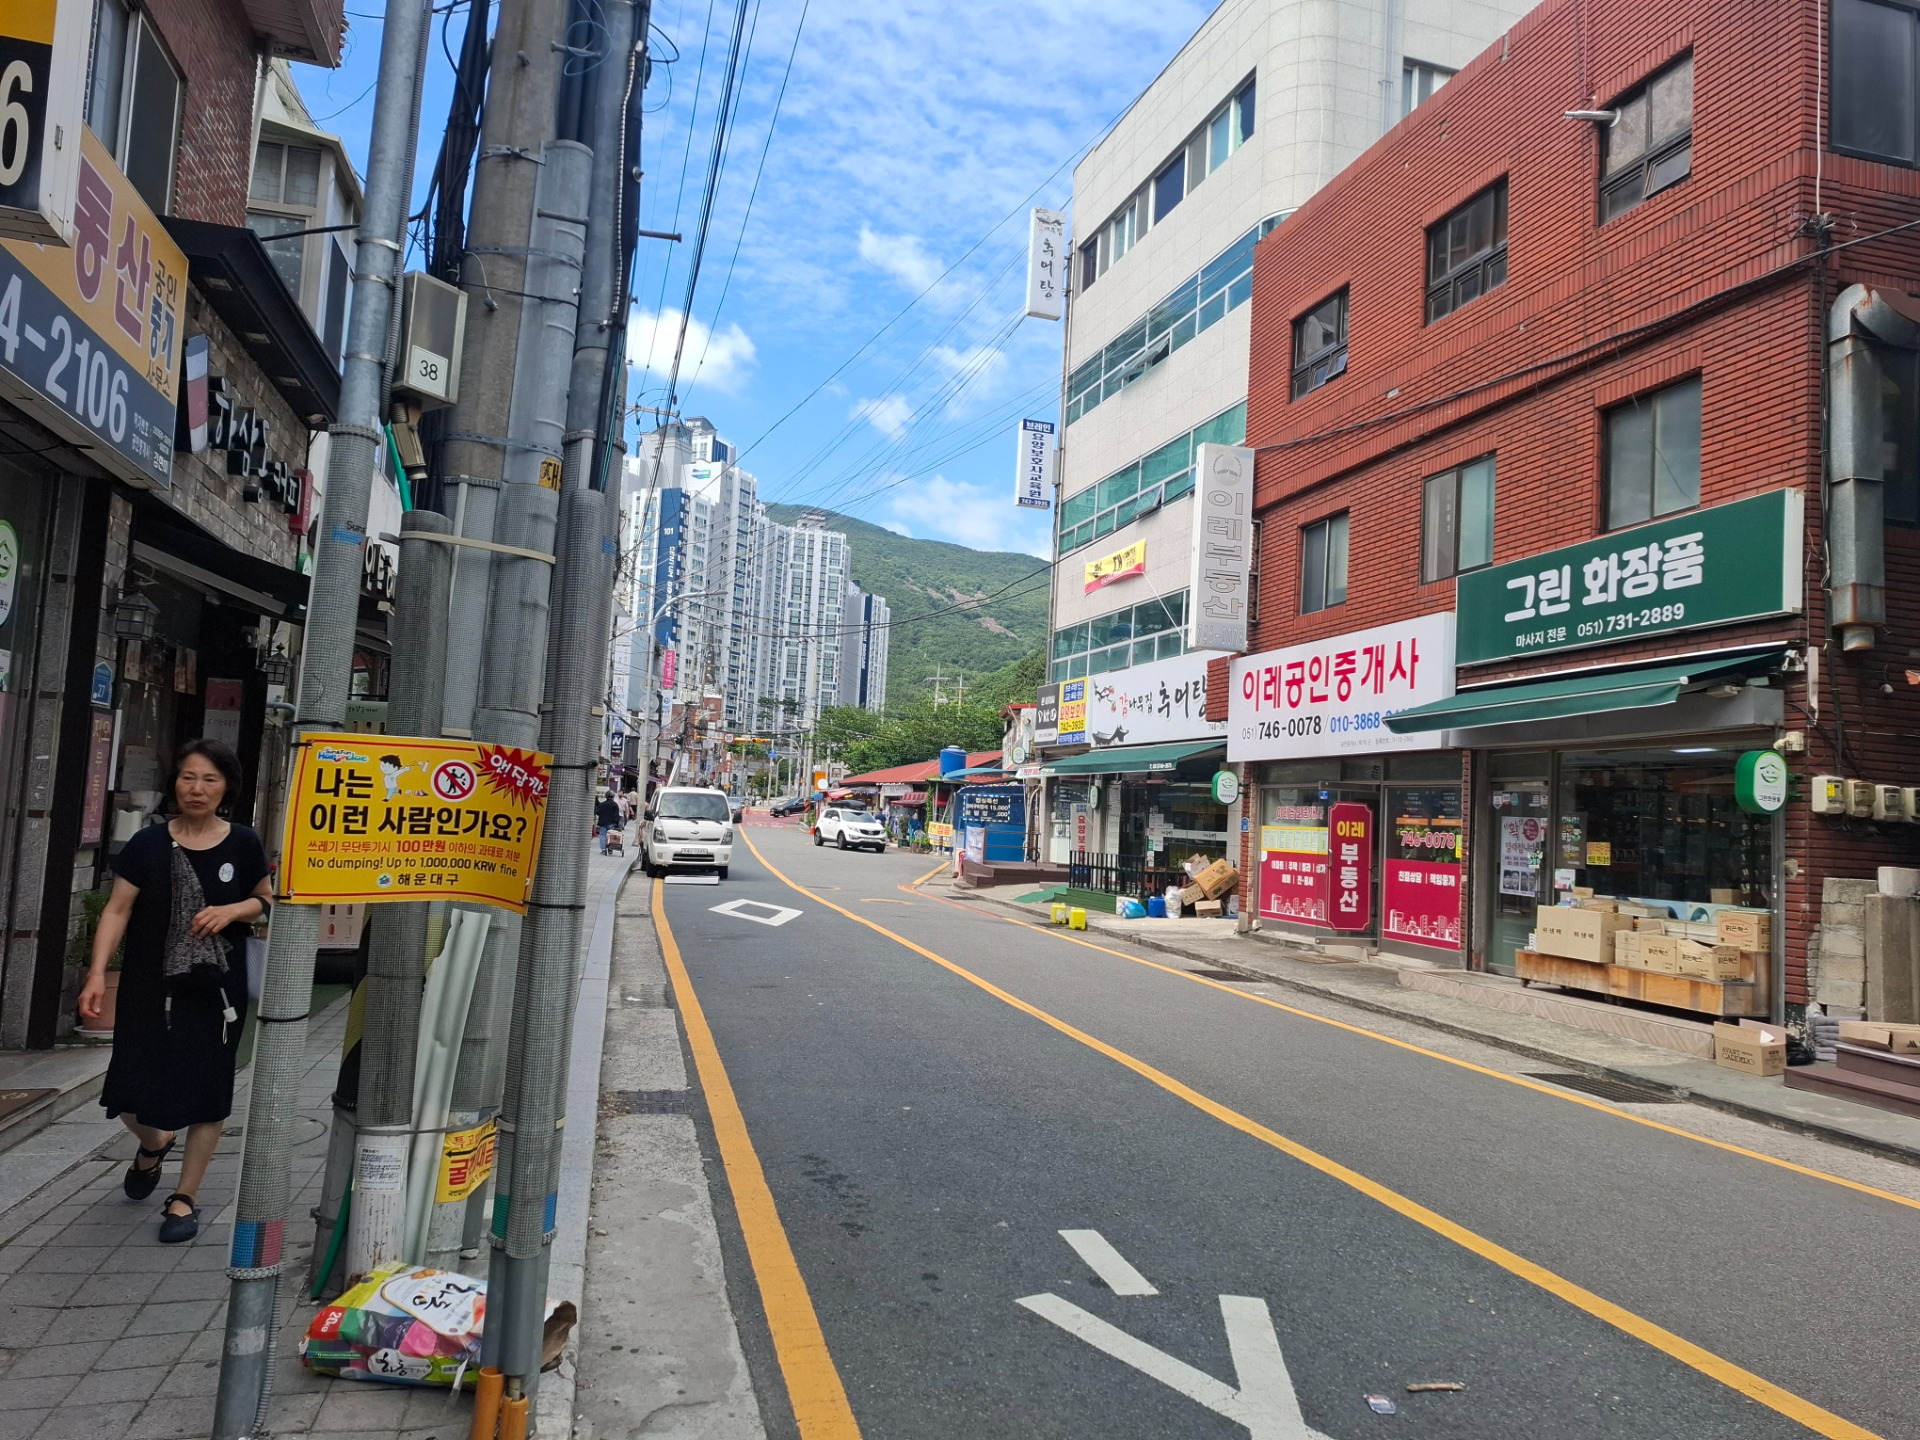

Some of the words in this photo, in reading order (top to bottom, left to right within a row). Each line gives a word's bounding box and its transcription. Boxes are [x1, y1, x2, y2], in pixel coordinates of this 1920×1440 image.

[1039, 238, 1055, 298] 추어탕
[419, 360, 438, 380] 38
[1026, 421, 1051, 432] 브레인
[1029, 433, 1045, 498] 요양보호사교육원
[664, 527, 674, 535] 101
[668, 546, 676, 578] CENTUM
[1203, 490, 1244, 620] 이레부동산
[1504, 565, 1571, 622] 그린
[1582, 532, 1705, 605] 화장품
[1515, 633, 1545, 648] 마사지
[1546, 626, 1567, 643] 전문
[1242, 637, 1419, 712] 이레공인중개사
[97, 684, 106, 697] 27
[1119, 692, 1153, 717] 감나무집
[315, 768, 374, 798] 나는
[309, 803, 369, 834] 이런
[377, 806, 527, 843] 사람인가요?
[1336, 821, 1365, 838] 이레
[307, 841, 338, 853] 쓰레기
[340, 842, 391, 853] 무단투기시
[396, 840, 446, 853] 100만원
[448, 842, 477, 855] 이하의
[478, 844, 504, 858] 과태료
[505, 849, 521, 863] 처분
[1400, 831, 1455, 849] 746-0078
[307, 857, 324, 868] No
[327, 857, 384, 869] dumping!
[386, 858, 402, 869] Up
[404, 858, 416, 867] to
[420, 857, 472, 869] 1,000,000
[473, 860, 497, 872] KRW
[499, 863, 518, 877] fine
[1339, 842, 1359, 913] 부동산
